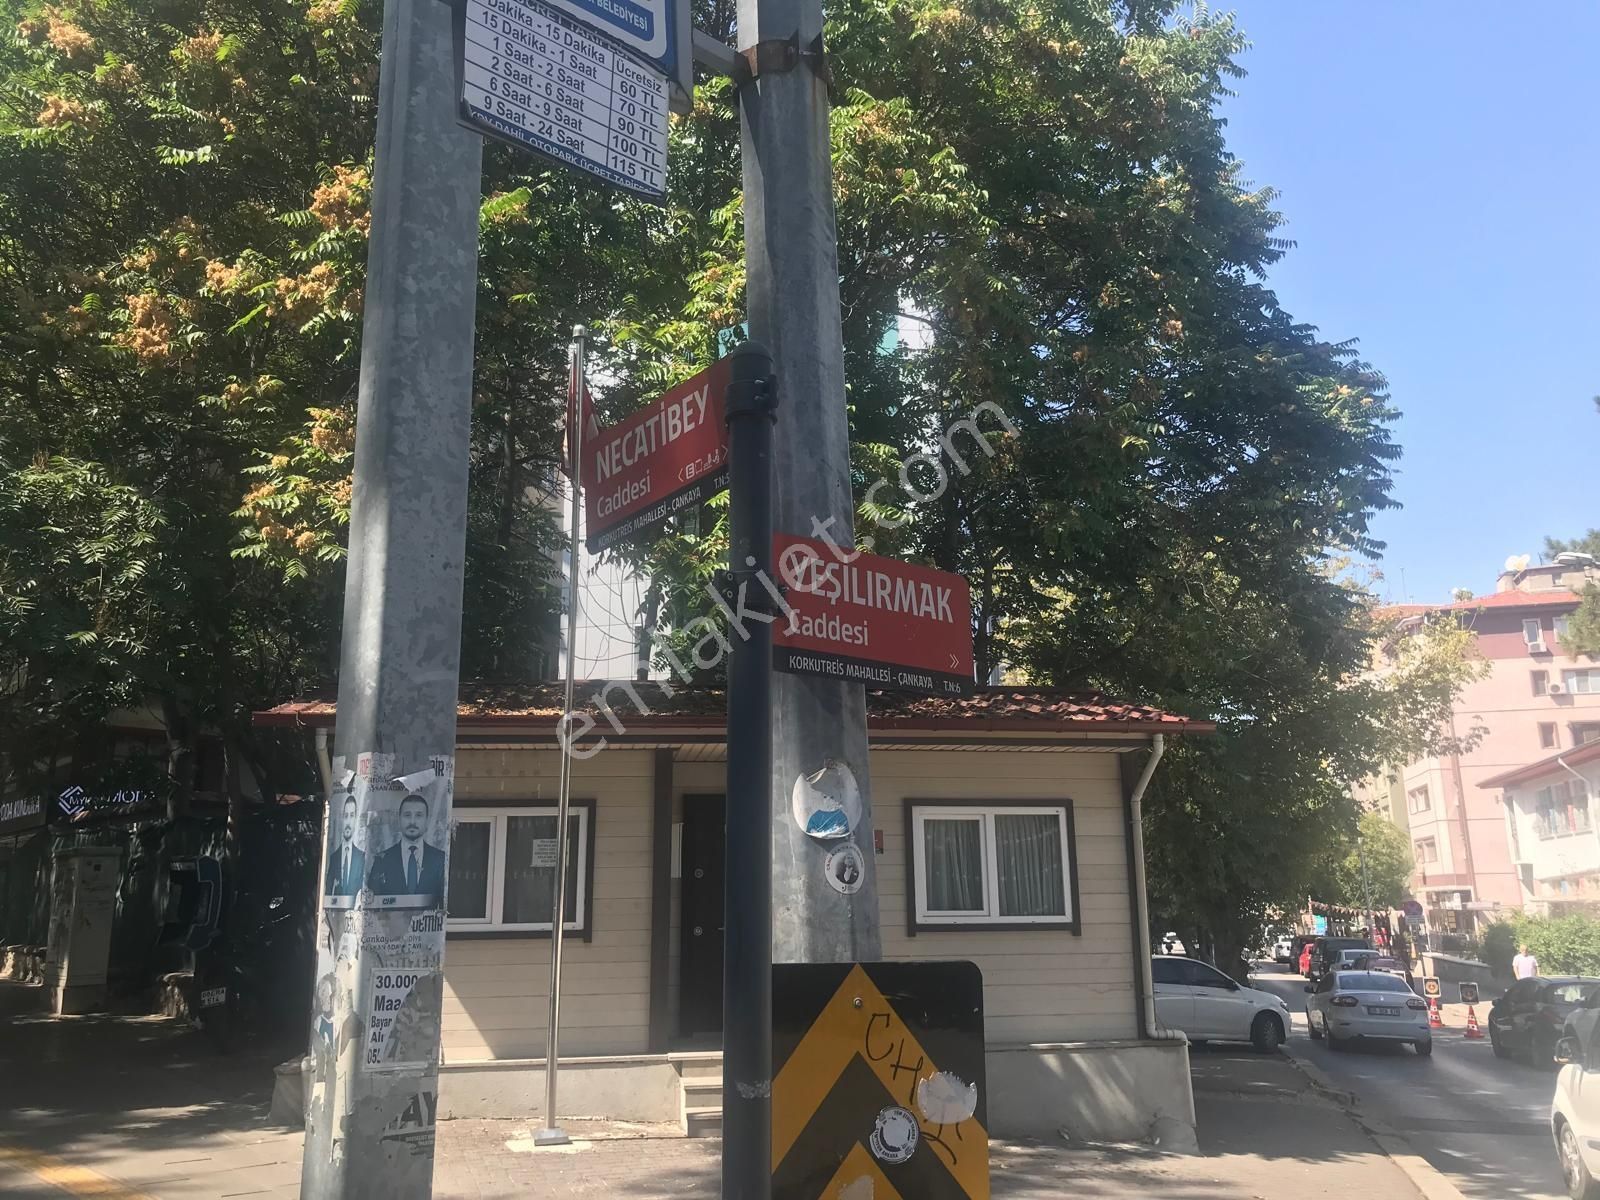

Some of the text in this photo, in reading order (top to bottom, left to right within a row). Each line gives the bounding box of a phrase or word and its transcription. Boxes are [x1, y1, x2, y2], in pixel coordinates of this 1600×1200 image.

[482, 11, 498, 28] 15
[502, 21, 546, 53] Dakika
[559, 50, 565, 63] 1
[569, 55, 597, 79] Saat
[620, 81, 637, 98] 60
[641, 90, 659, 110] TL
[493, 37, 499, 50] 1
[505, 42, 534, 68] Saat
[546, 63, 553, 77] 2
[557, 69, 585, 93] Saat
[619, 98, 636, 117] 70
[640, 108, 658, 128] TL
[545, 24, 560, 40] 15
[564, 32, 605, 64] Dakika
[616, 59, 662, 93] Ücretsiz
[490, 77, 497, 91] 6
[502, 82, 531, 108] Saat
[543, 102, 551, 116] 9
[555, 108, 583, 132] Saat
[613, 135, 637, 156] 100
[642, 147, 660, 168] TL
[491, 57, 499, 71] 2
[504, 62, 533, 88] Saat
[545, 82, 552, 96] 6
[556, 88, 584, 112] Saat
[618, 117, 635, 135] 90
[640, 126, 657, 146] TL
[484, 96, 492, 110] 9
[496, 101, 526, 126] Saat
[538, 121, 553, 138] 24
[557, 130, 584, 153] Saat
[612, 156, 636, 176] 115
[641, 167, 658, 187] TL
[529, 138, 577, 164] OTOPARK
[596, 384, 708, 483] NECATİBEY
[597, 469, 650, 518] Caddesi
[633, 501, 667, 531] MAHALLESİ
[671, 486, 701, 512] ÇANKAYA
[788, 553, 954, 624] YEŞİLIRMAK
[789, 608, 868, 646] Caddesi
[789, 655, 844, 675] KORKUTREİS
[846, 664, 891, 683] MAHALLESİ
[898, 672, 933, 689] ÇANKAYA
